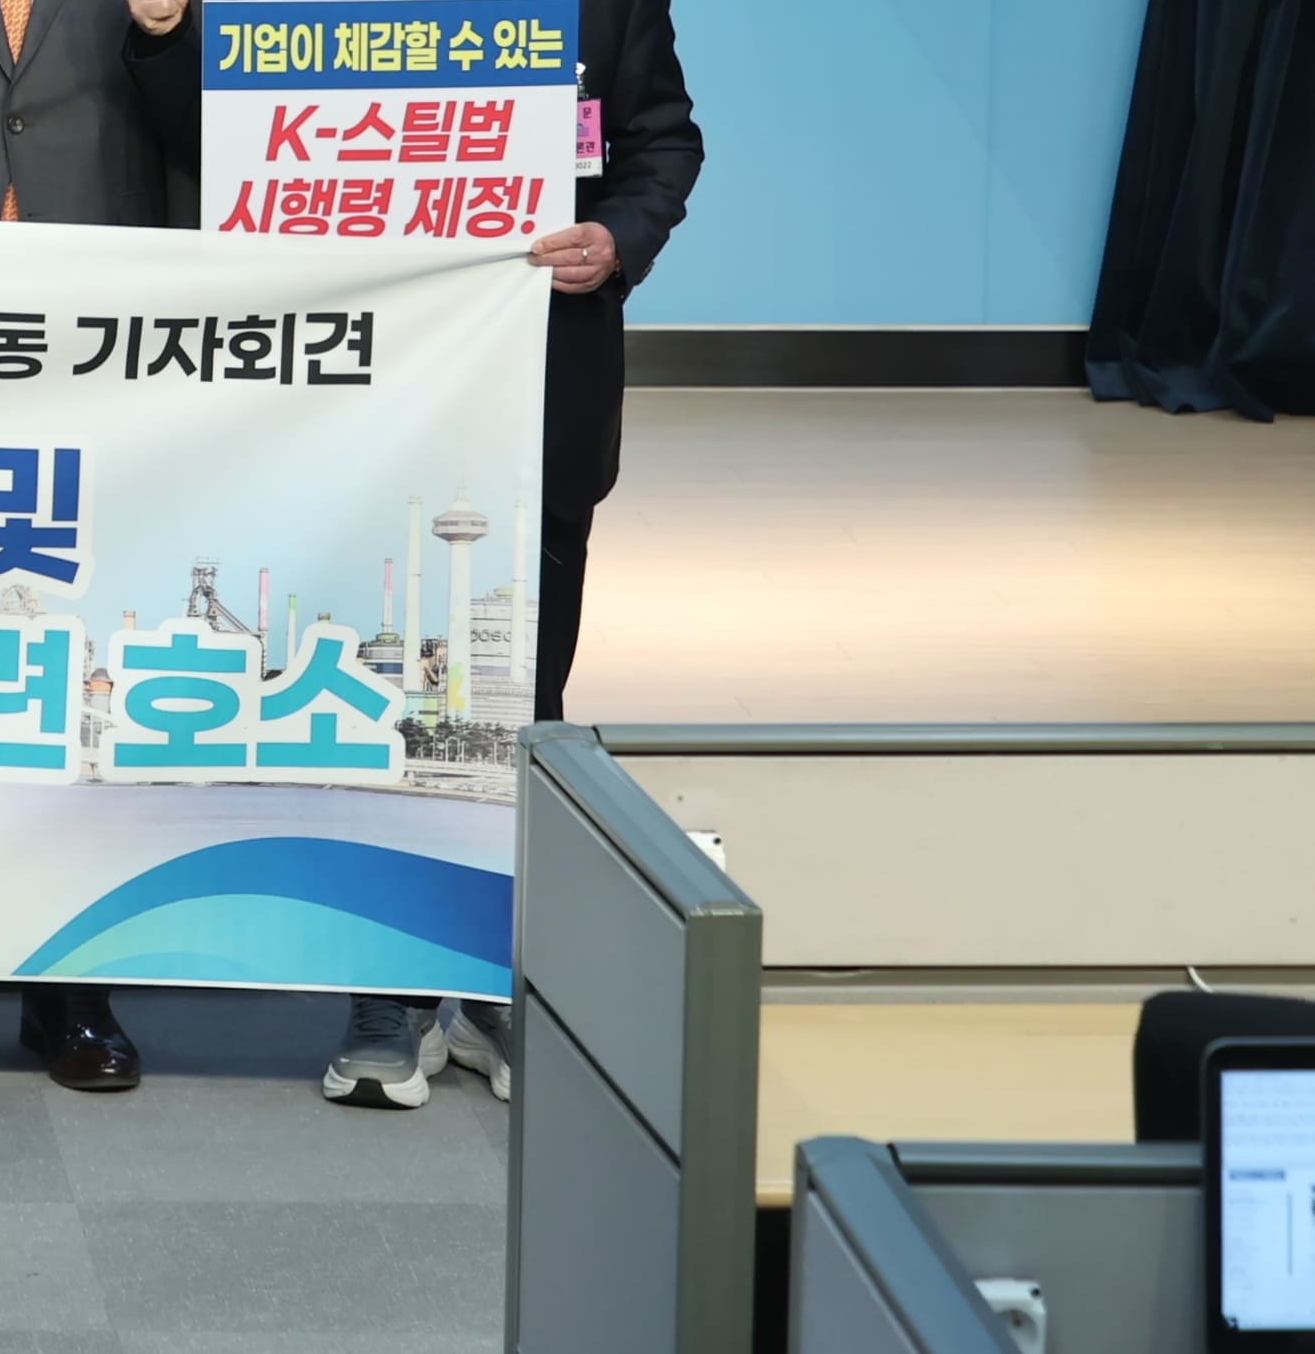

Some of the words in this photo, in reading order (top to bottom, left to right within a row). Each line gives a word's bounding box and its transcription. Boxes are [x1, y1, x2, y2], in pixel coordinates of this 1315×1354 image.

[218, 22, 323, 73] 기업이
[334, 20, 441, 72] 체감할
[449, 20, 484, 72] 수
[493, 18, 564, 70] 있는
[265, 99, 515, 163] K-스틸법
[219, 176, 395, 238] 시행령
[403, 175, 545, 238] 제정!
[71, 312, 374, 386] 기자회견
[112, 632, 392, 772] 호소
